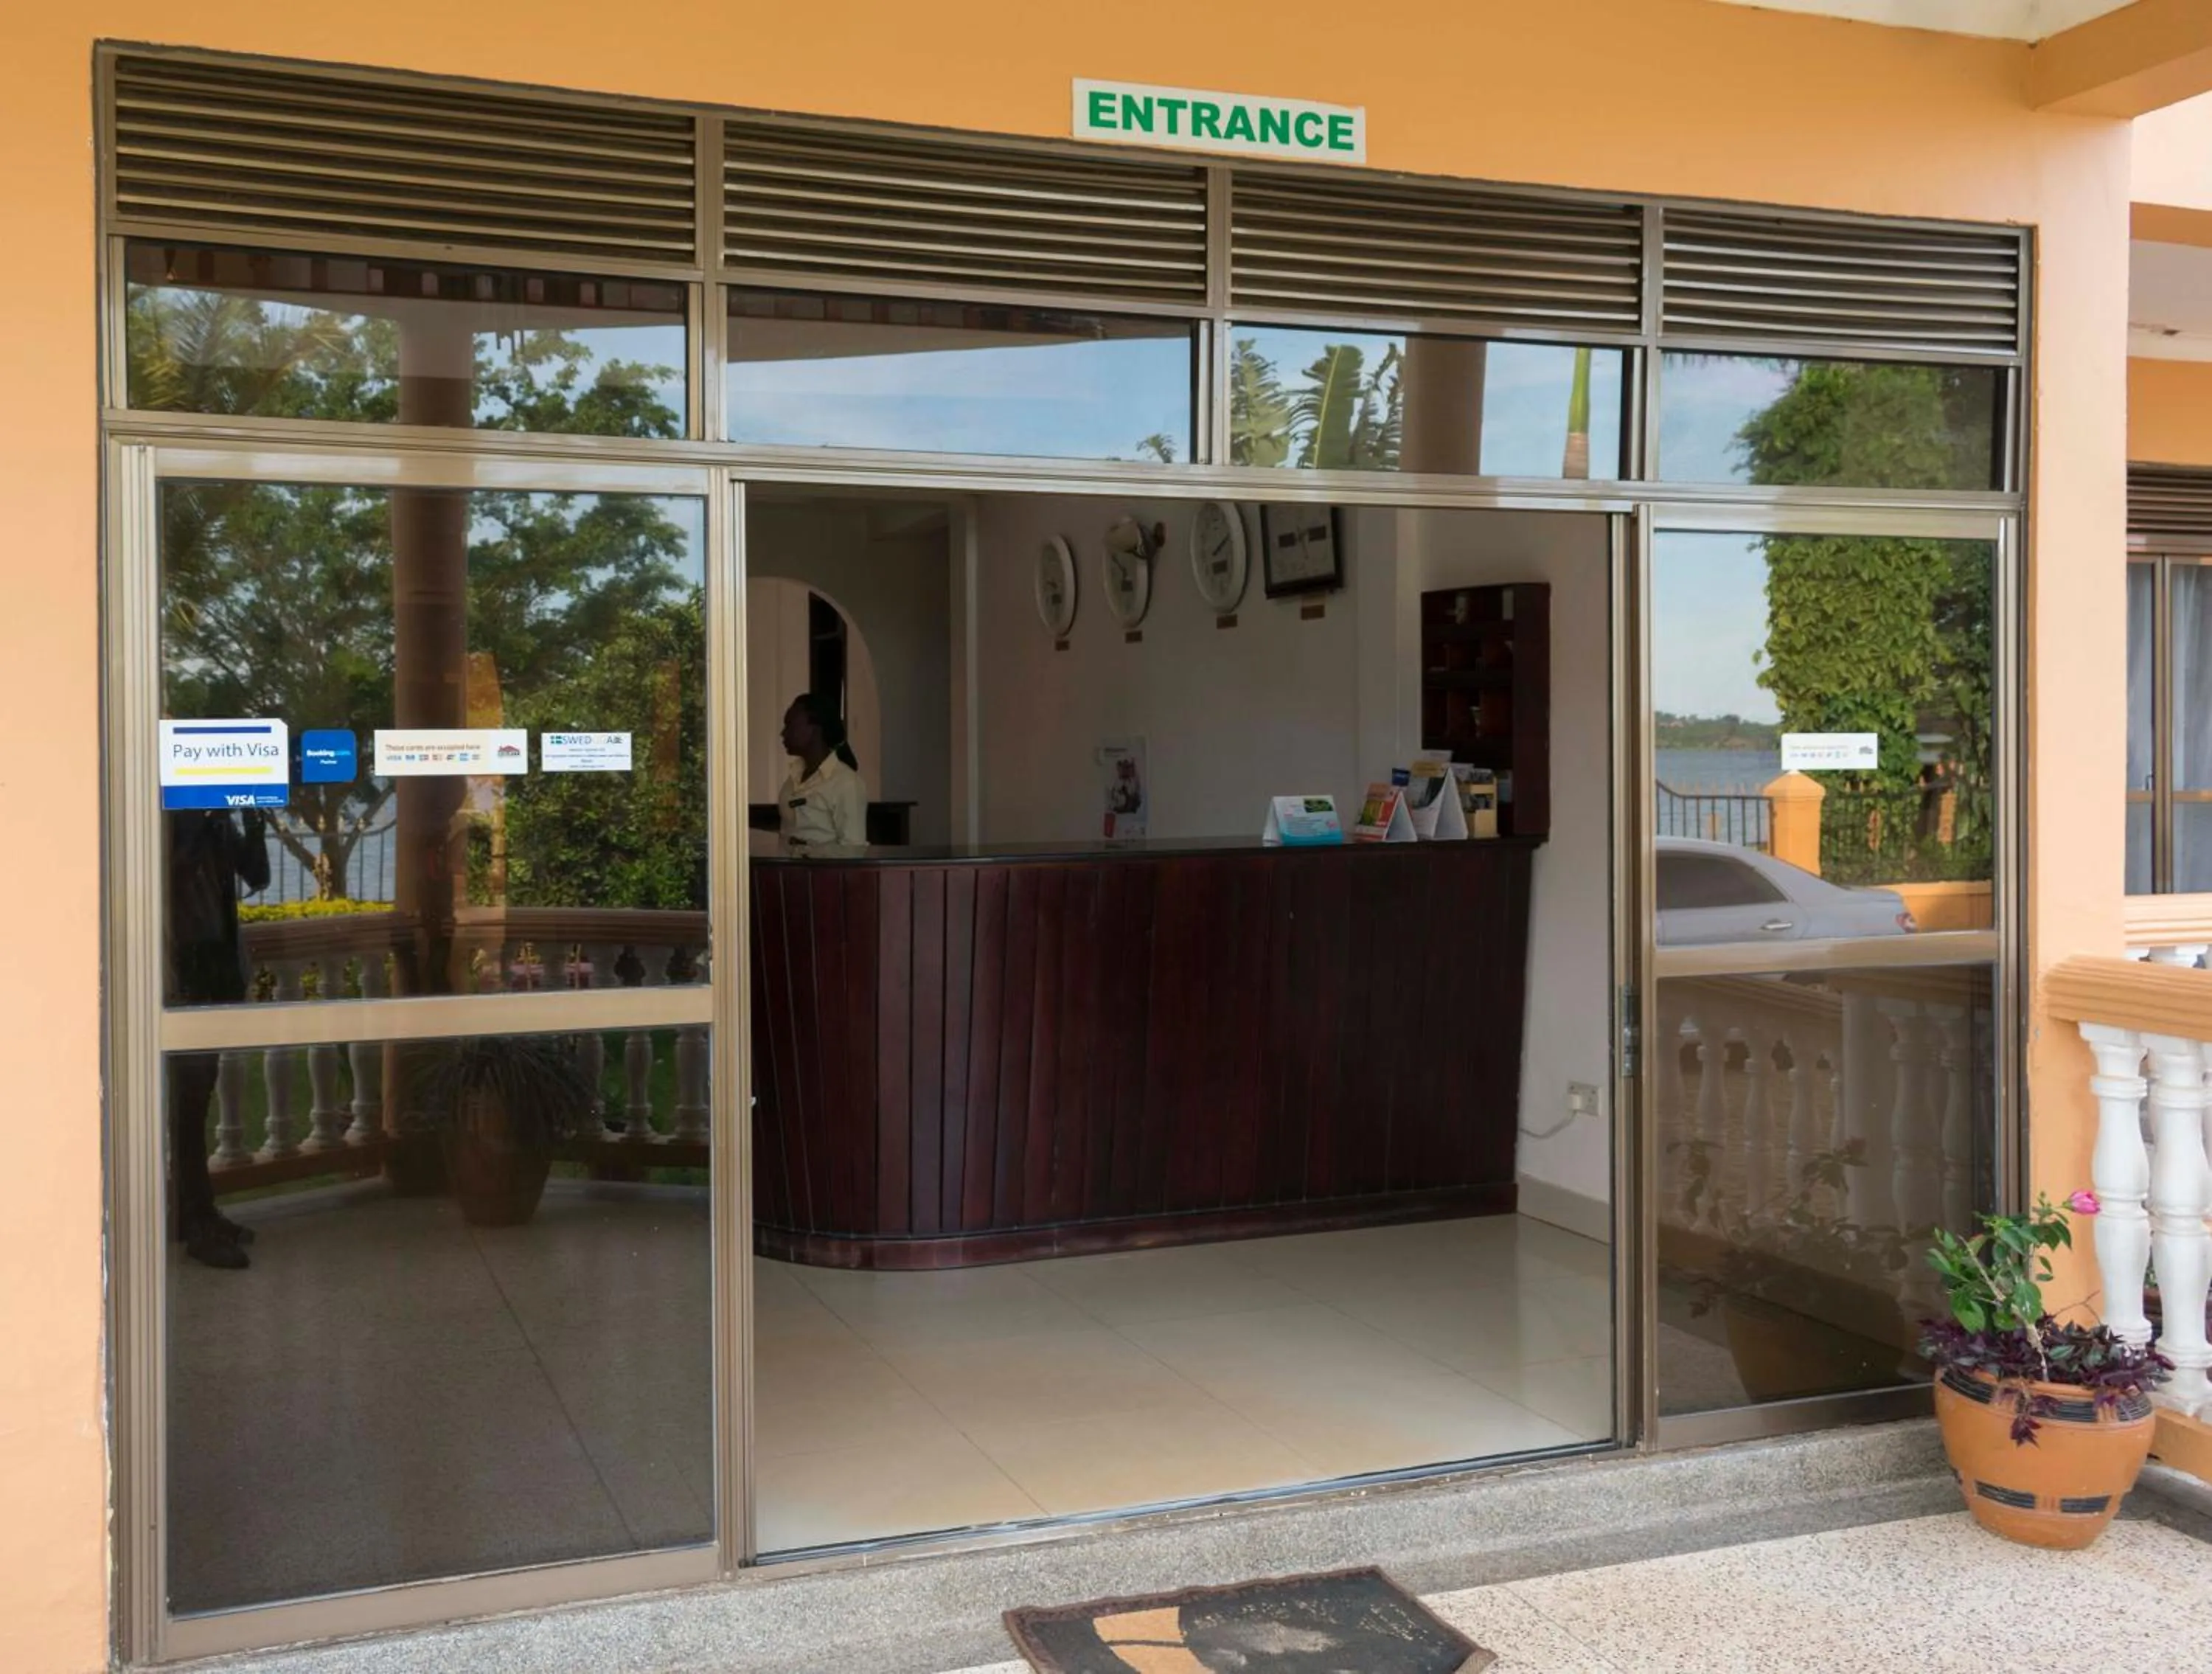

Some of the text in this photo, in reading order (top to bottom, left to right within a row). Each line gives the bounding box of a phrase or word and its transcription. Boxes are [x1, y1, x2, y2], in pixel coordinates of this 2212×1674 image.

[1088, 91, 1355, 151] ENTRANCE
[173, 743, 279, 761] Pay with Visa
[224, 794, 255, 806] VISA
